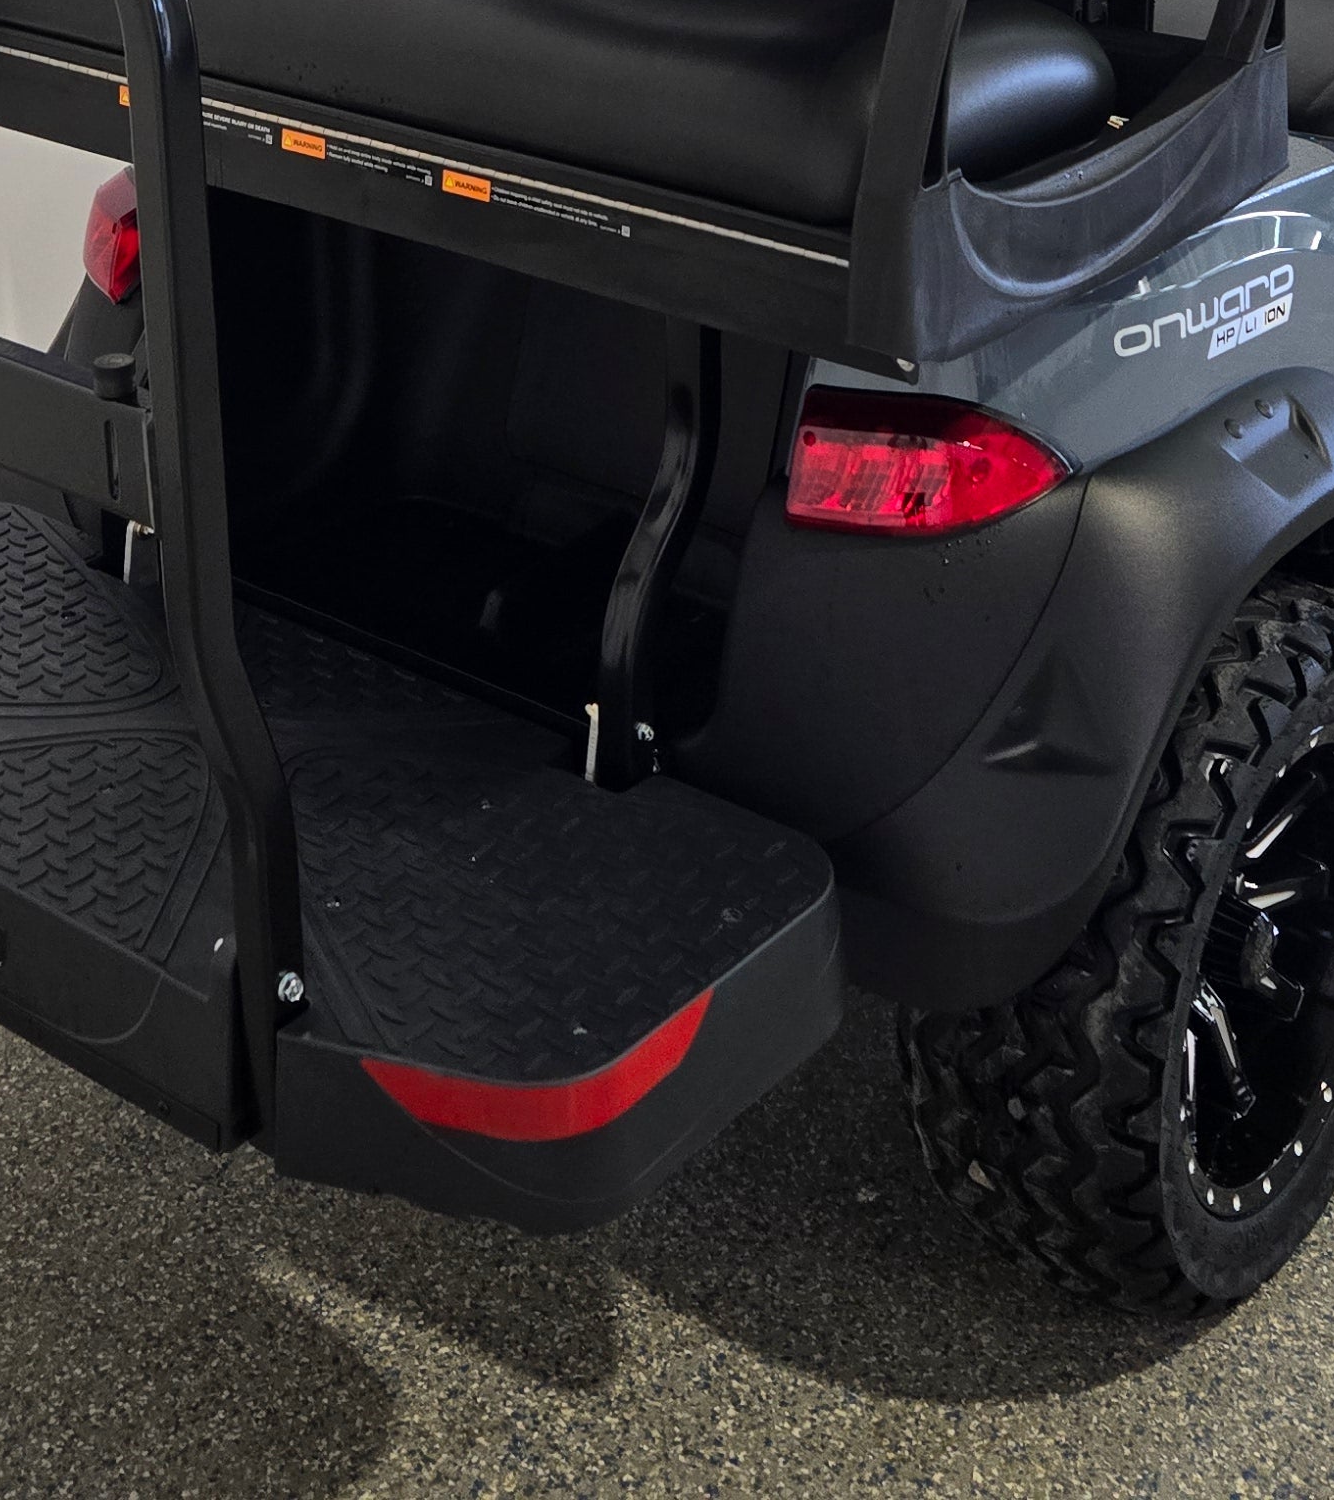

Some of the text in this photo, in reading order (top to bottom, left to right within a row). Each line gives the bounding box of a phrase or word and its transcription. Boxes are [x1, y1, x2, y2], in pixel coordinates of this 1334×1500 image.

[293, 139, 323, 152] WARNING
[454, 180, 487, 194] WARNING
[1216, 327, 1236, 348] HP
